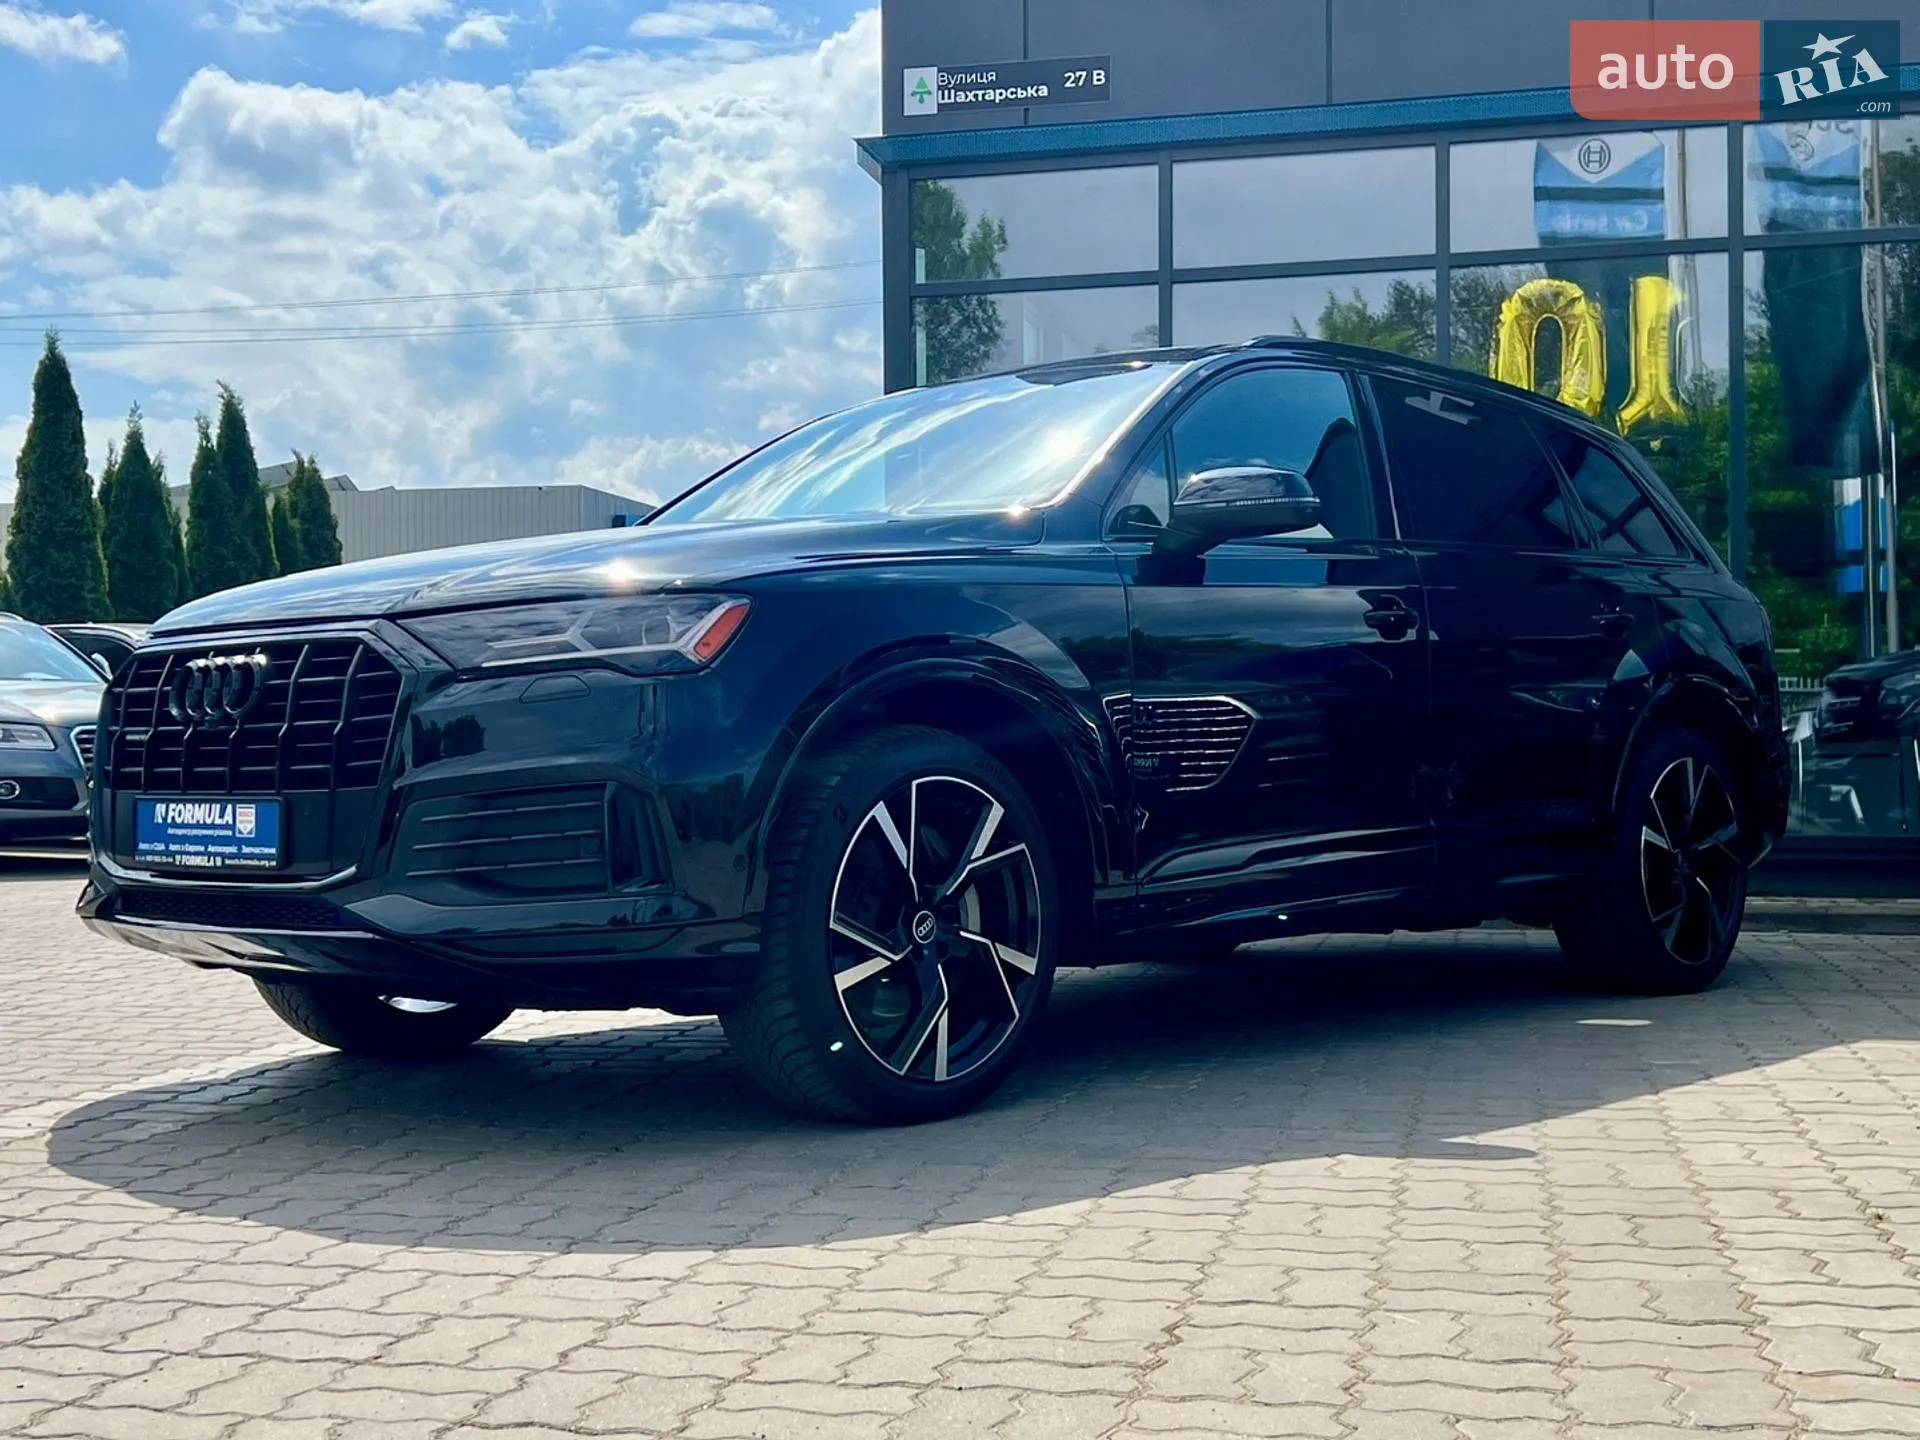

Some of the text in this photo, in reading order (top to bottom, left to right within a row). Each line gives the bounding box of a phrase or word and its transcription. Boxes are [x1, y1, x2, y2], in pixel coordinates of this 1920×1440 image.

[938, 71, 996, 88] Вулиця
[1064, 70, 1106, 88] 27 В
[937, 84, 1049, 104] Шахтарська
[167, 803, 233, 825] FORMULA
